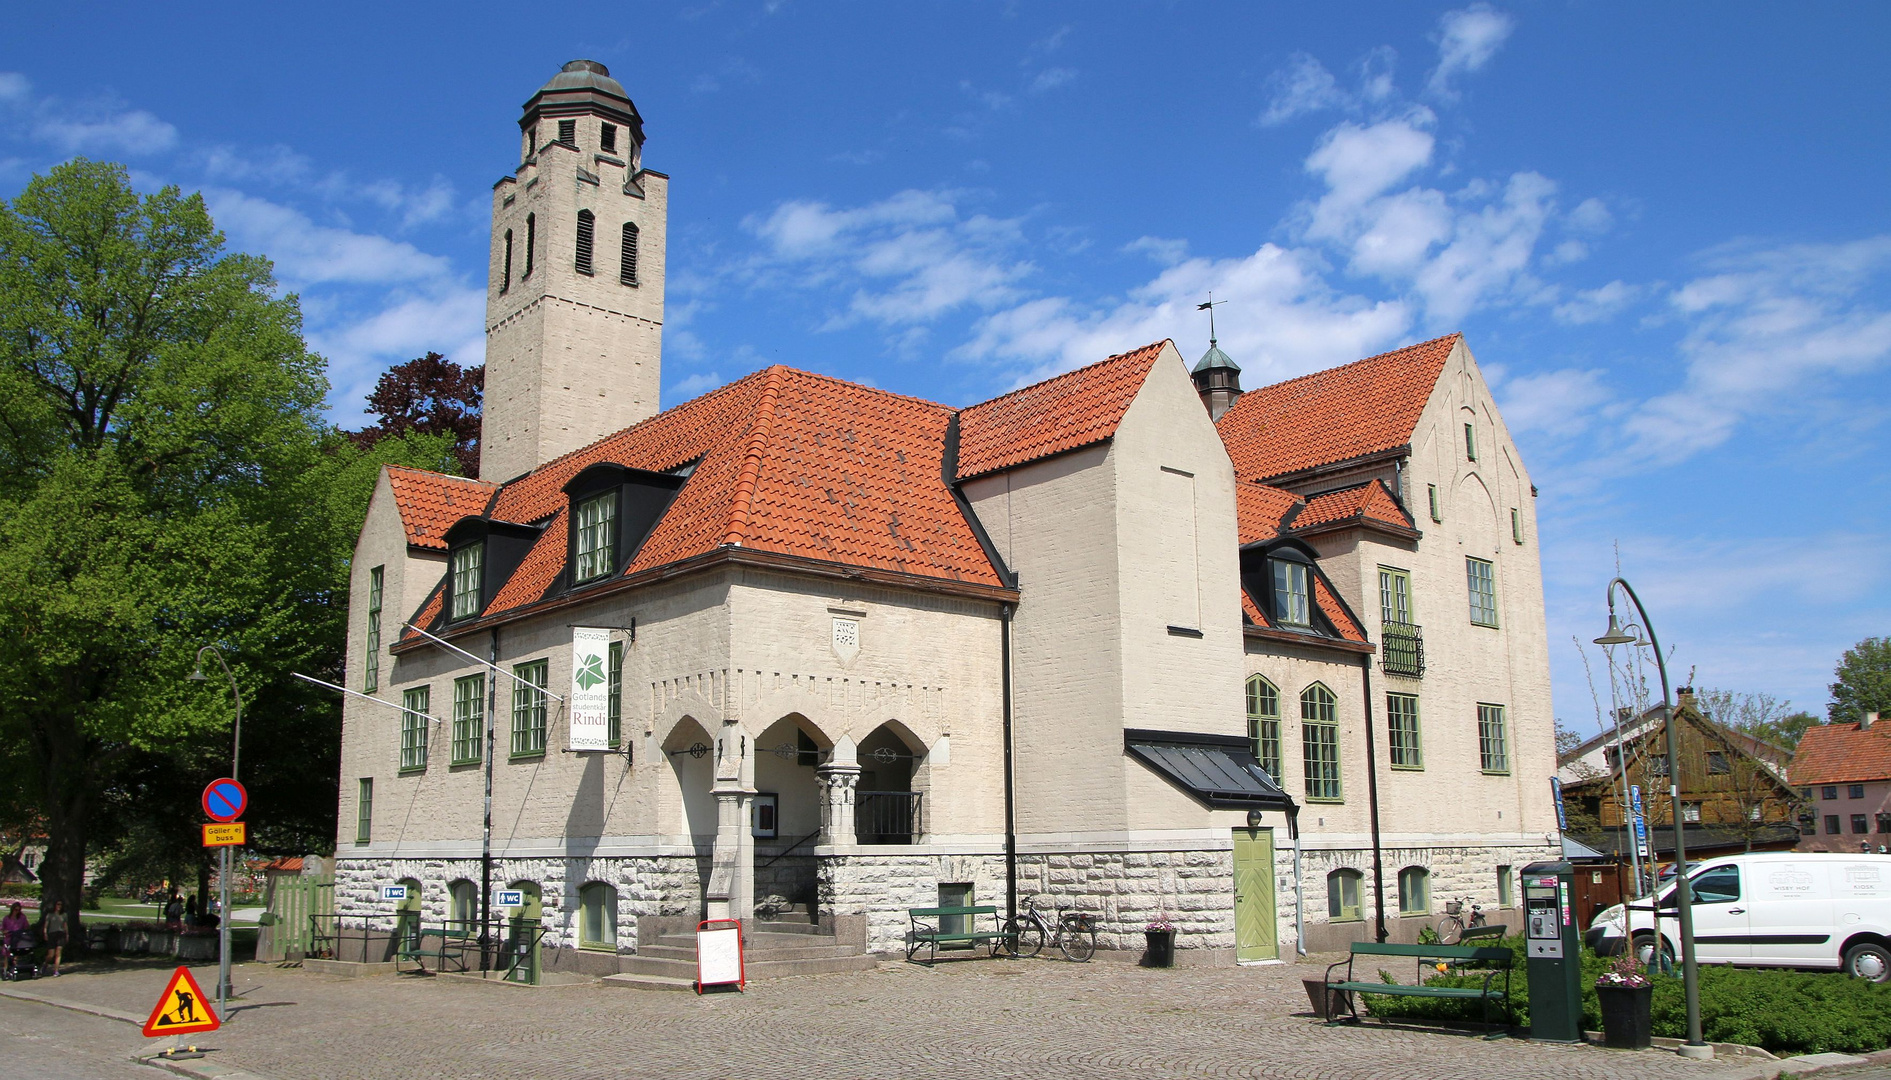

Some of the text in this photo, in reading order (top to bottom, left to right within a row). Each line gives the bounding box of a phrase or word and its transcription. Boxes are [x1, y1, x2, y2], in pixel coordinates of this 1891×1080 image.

[572, 692, 606, 701] Gotlands
[572, 702, 606, 711] studentkår
[573, 712, 606, 726] Rindi
[844, 789, 848, 803] 1
